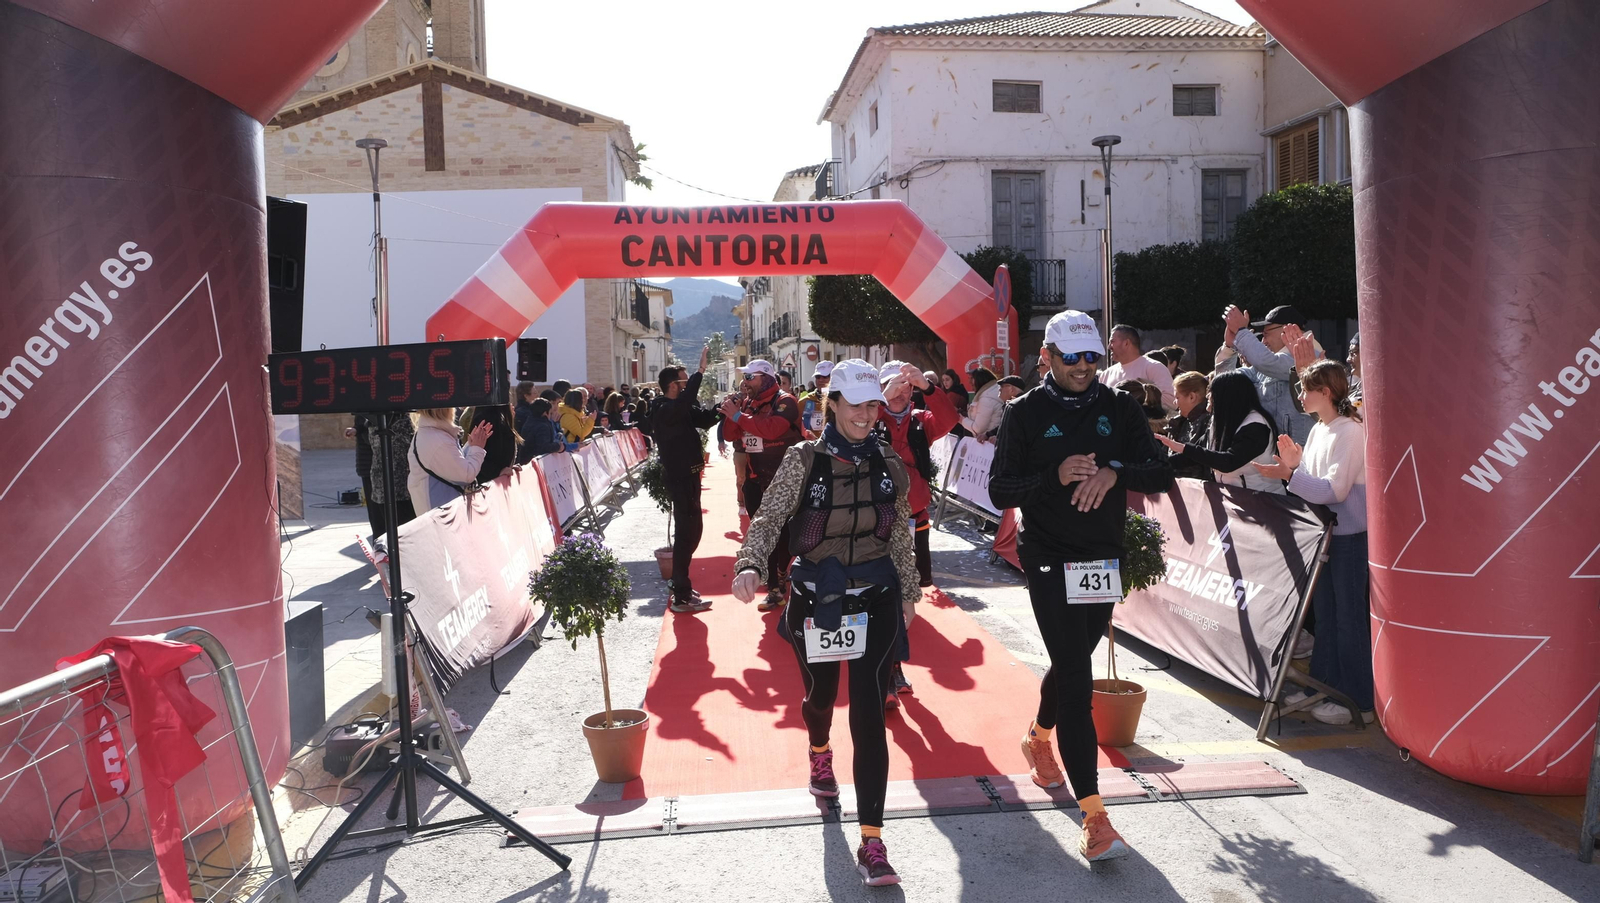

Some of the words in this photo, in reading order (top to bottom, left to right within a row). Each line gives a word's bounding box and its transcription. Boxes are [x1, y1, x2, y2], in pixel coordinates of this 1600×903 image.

[614, 205, 835, 224] AYUNTAMIENTO
[621, 234, 828, 267] CANTORIA
[1077, 323, 1093, 331] ROMA
[862, 372, 878, 381] ROMA
[745, 437, 758, 447] 432
[1079, 572, 1111, 591] 431
[1161, 557, 1265, 611] TEAMERGY
[437, 584, 491, 653] TEAMERGY
[820, 629, 855, 649] 549
